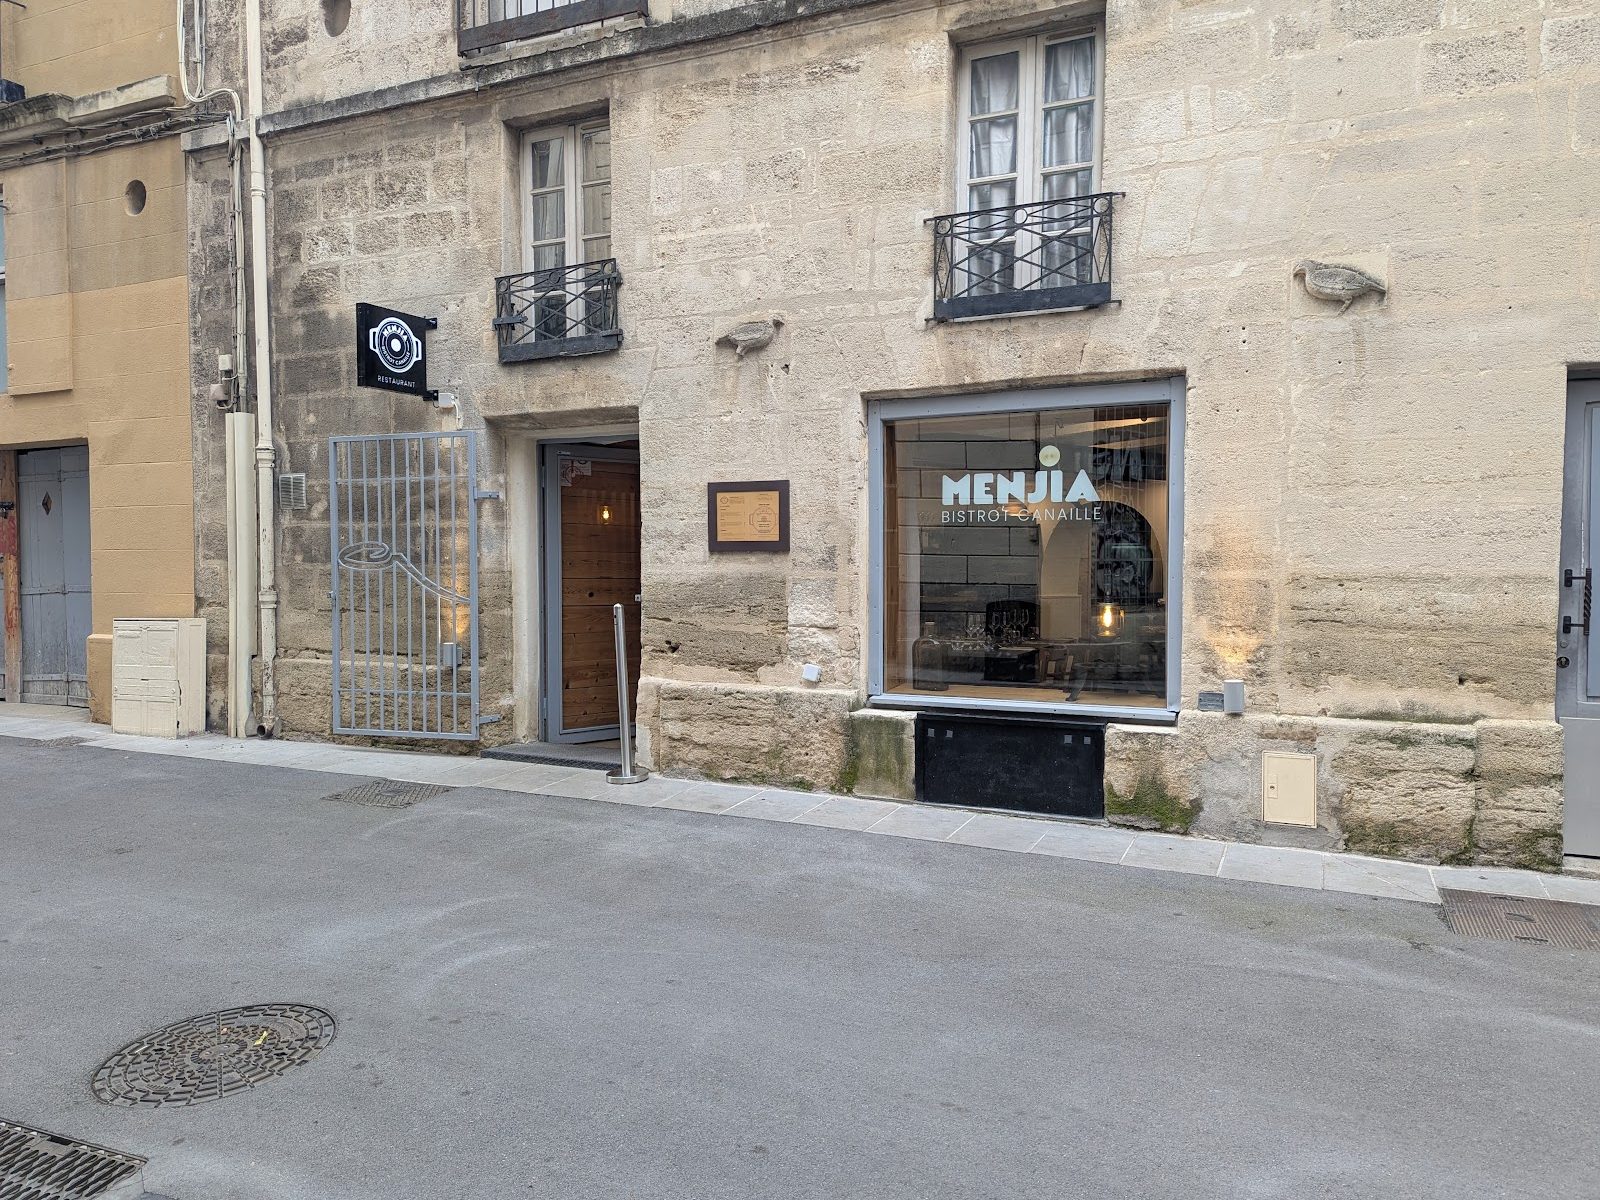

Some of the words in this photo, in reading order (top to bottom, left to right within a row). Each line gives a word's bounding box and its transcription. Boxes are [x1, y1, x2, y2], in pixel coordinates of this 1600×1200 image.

[377, 375, 416, 388] RESTAURANT
[942, 469, 1101, 506] MENJIA
[941, 509, 1008, 523] BISTROT
[1018, 507, 1102, 522] CANAILLE
